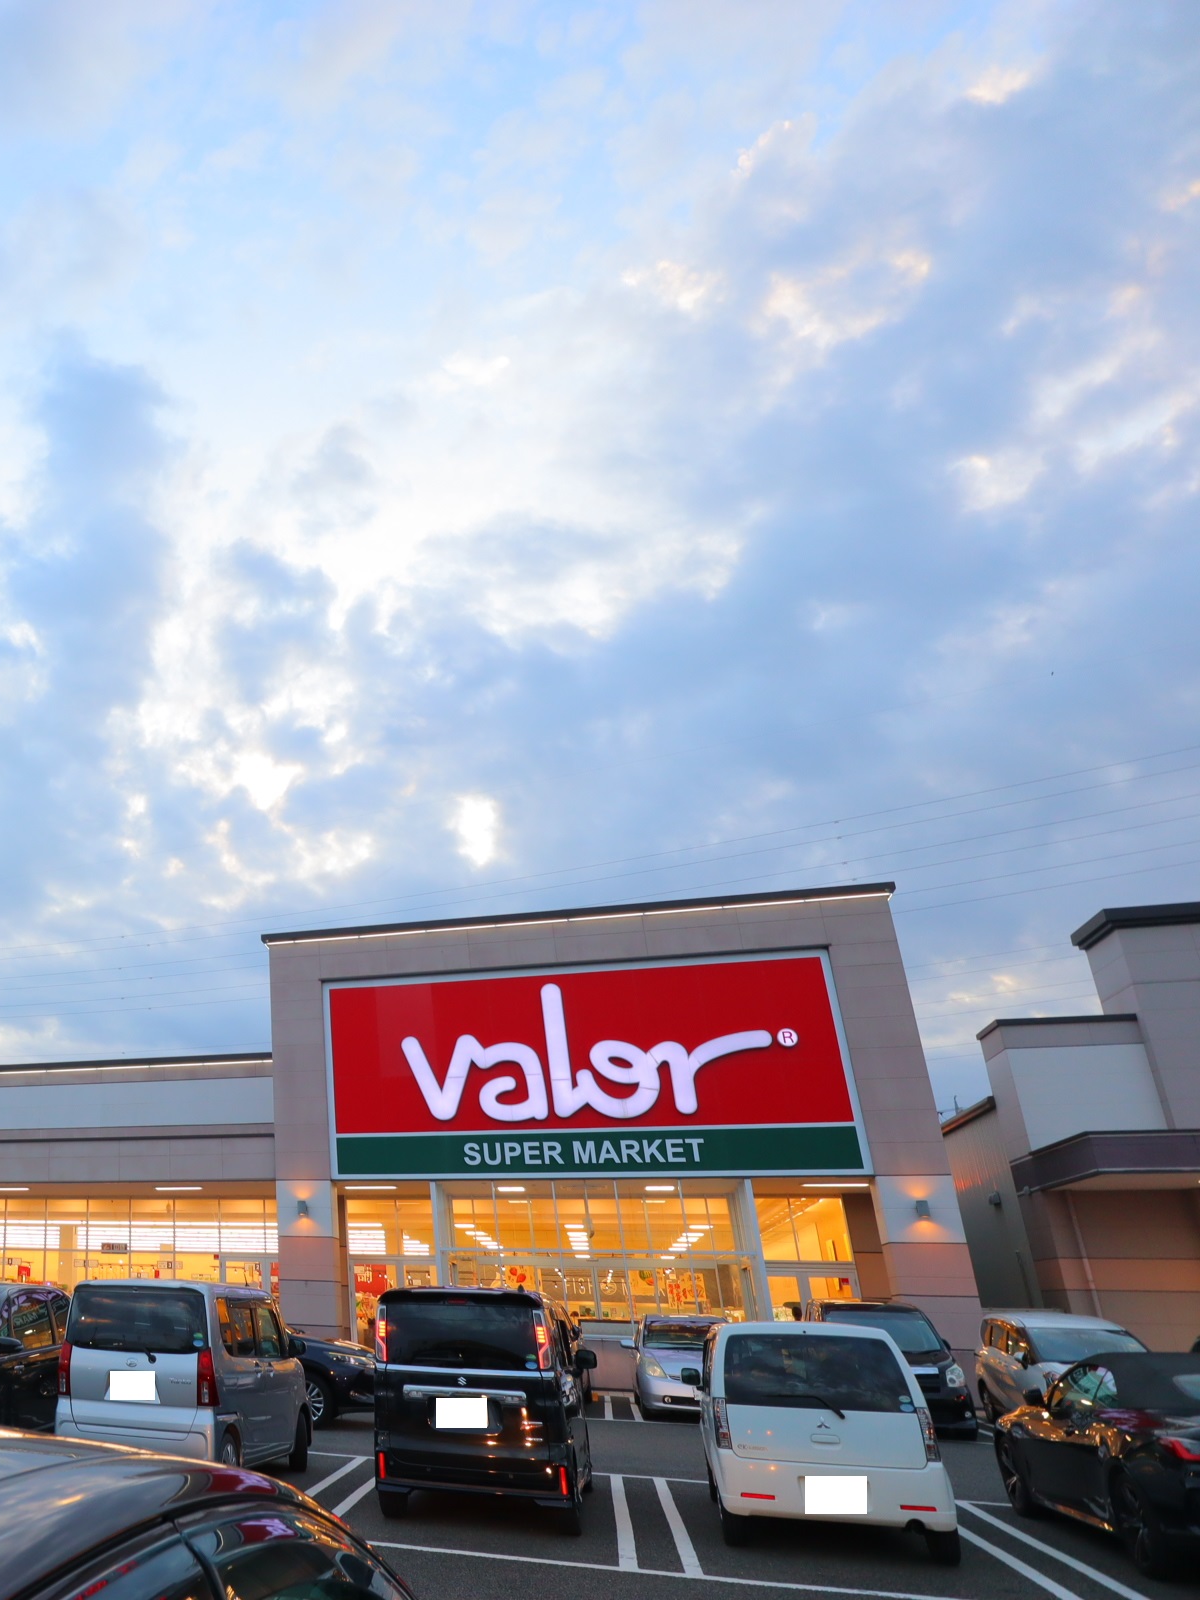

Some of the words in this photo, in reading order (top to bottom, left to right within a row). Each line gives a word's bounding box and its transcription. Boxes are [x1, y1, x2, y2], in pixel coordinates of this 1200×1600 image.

[401, 983, 773, 1121] valor
[463, 1141, 565, 1166] SUPER
[572, 1138, 705, 1165] MARKET
